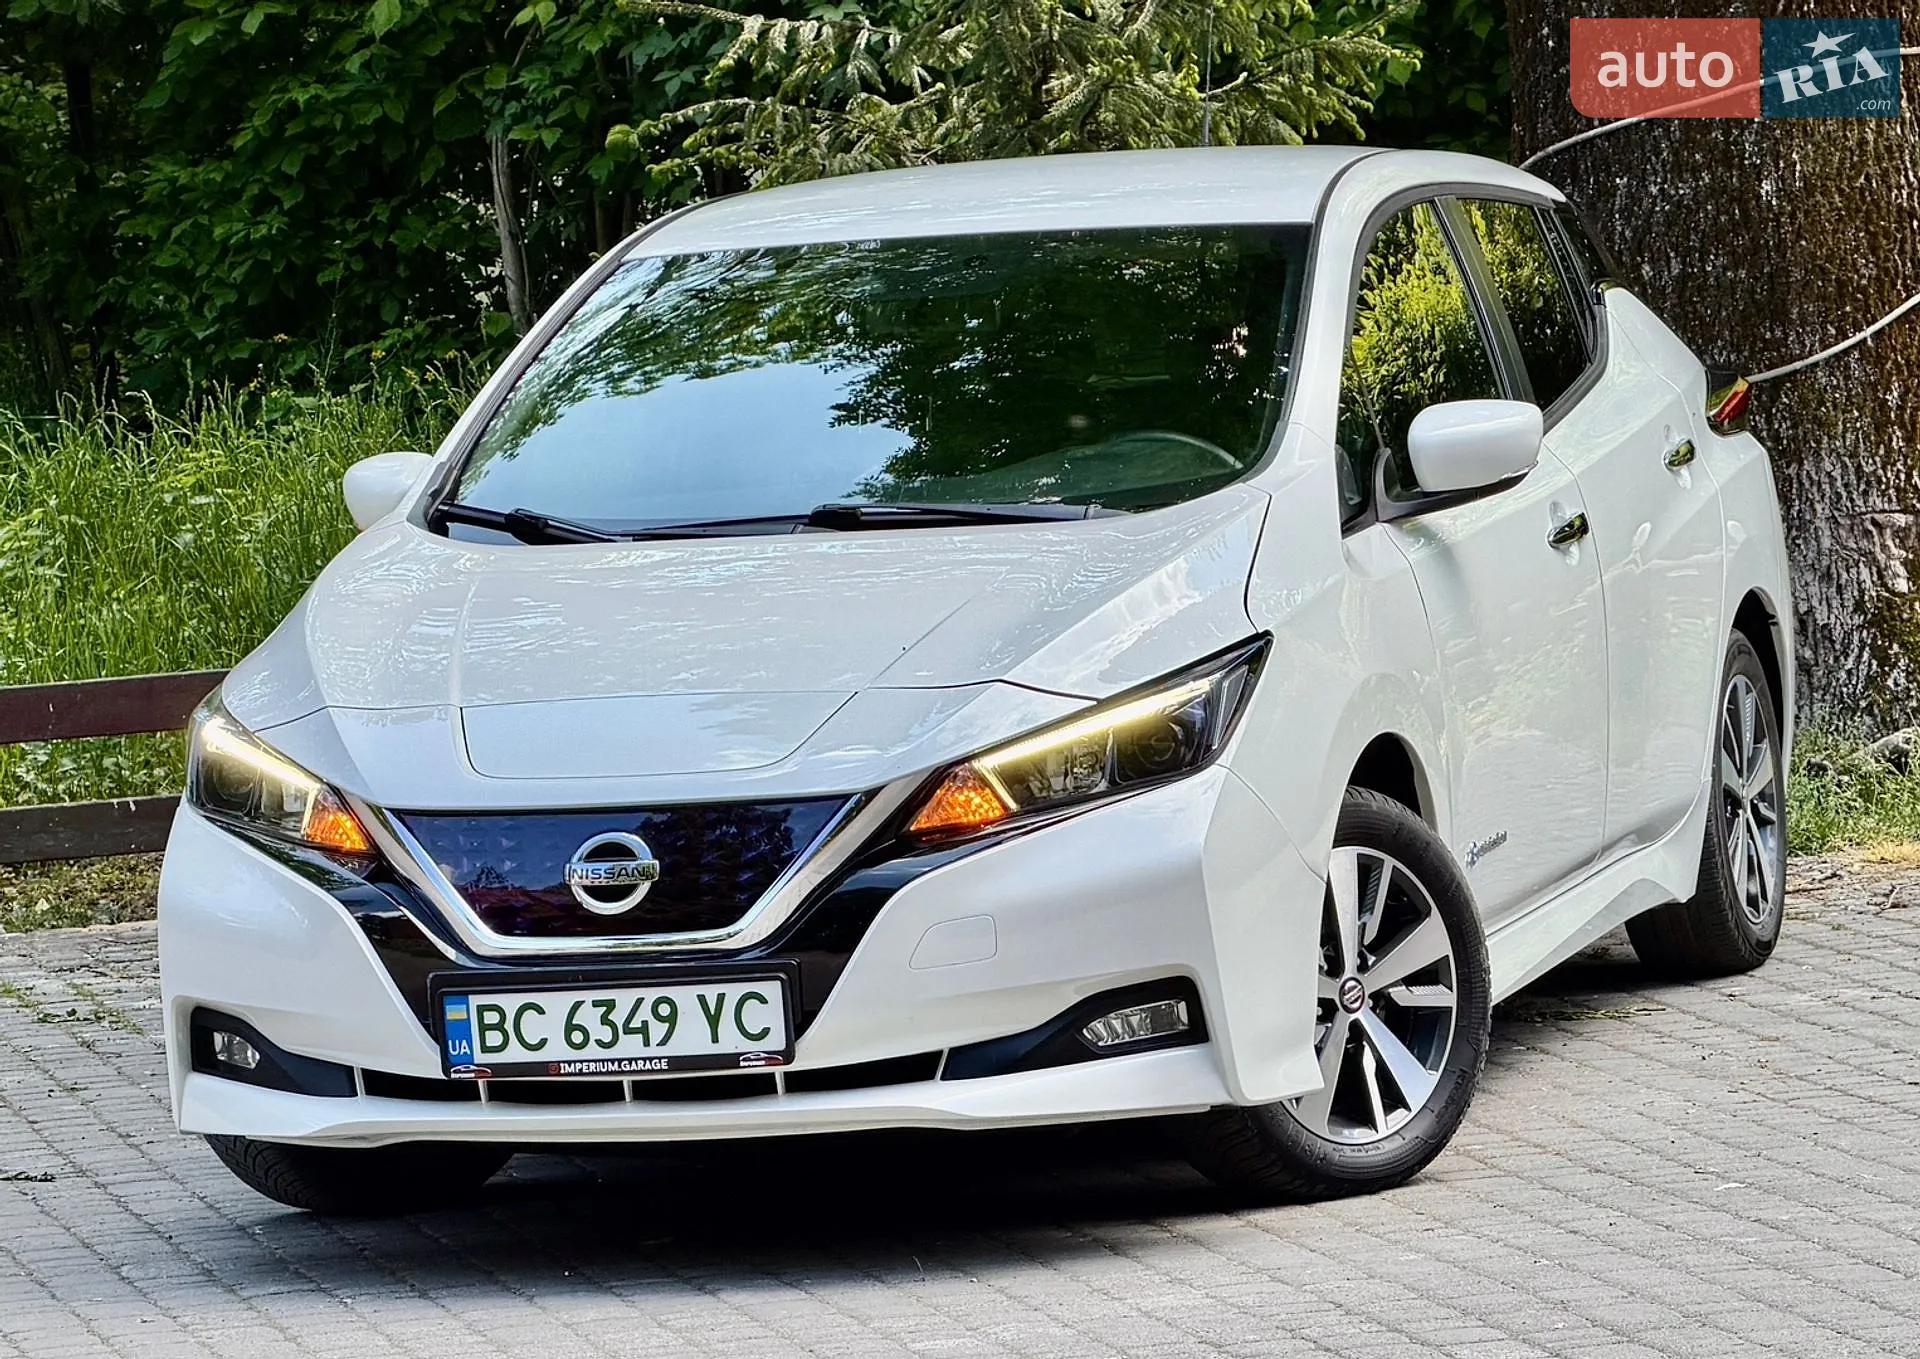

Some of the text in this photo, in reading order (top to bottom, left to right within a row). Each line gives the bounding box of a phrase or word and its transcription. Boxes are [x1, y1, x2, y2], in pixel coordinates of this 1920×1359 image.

[571, 865, 646, 881] NISSAN
[475, 991, 772, 1054] BC 6349 YC
[448, 1038, 471, 1056] UA
[560, 1058, 669, 1074] IMPERIUM.GARAGE
